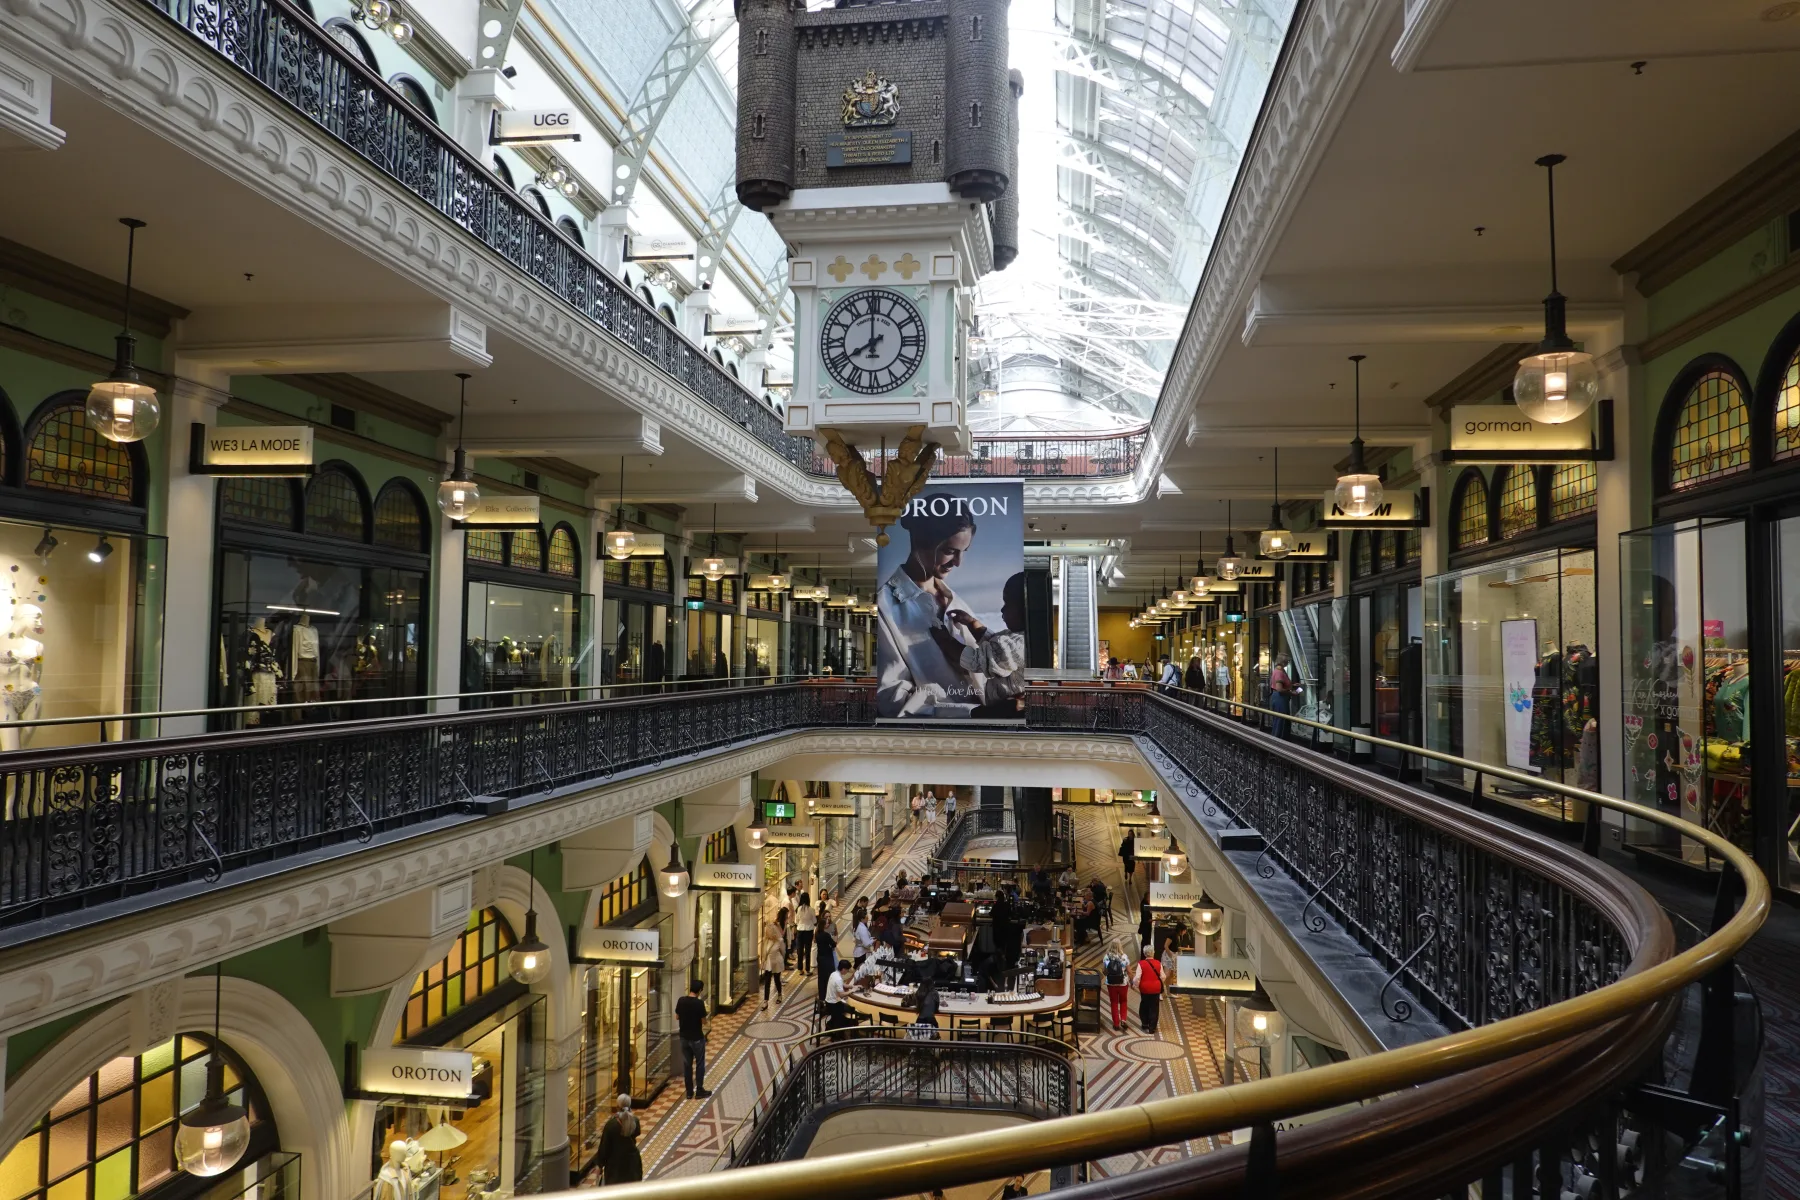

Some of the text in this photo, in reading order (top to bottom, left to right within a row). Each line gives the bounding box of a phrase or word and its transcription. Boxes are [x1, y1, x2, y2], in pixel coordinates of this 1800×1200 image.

[534, 113, 569, 126] UGG
[1465, 422, 1532, 435] gorman
[211, 439, 300, 451] WE3 LA MODE
[946, 684, 964, 696] love
[713, 872, 752, 880] OROTON
[1169, 892, 1200, 900] charlott
[603, 940, 653, 951] OROTON
[1193, 968, 1250, 980] WAMADA
[392, 1066, 462, 1082] OROTON
